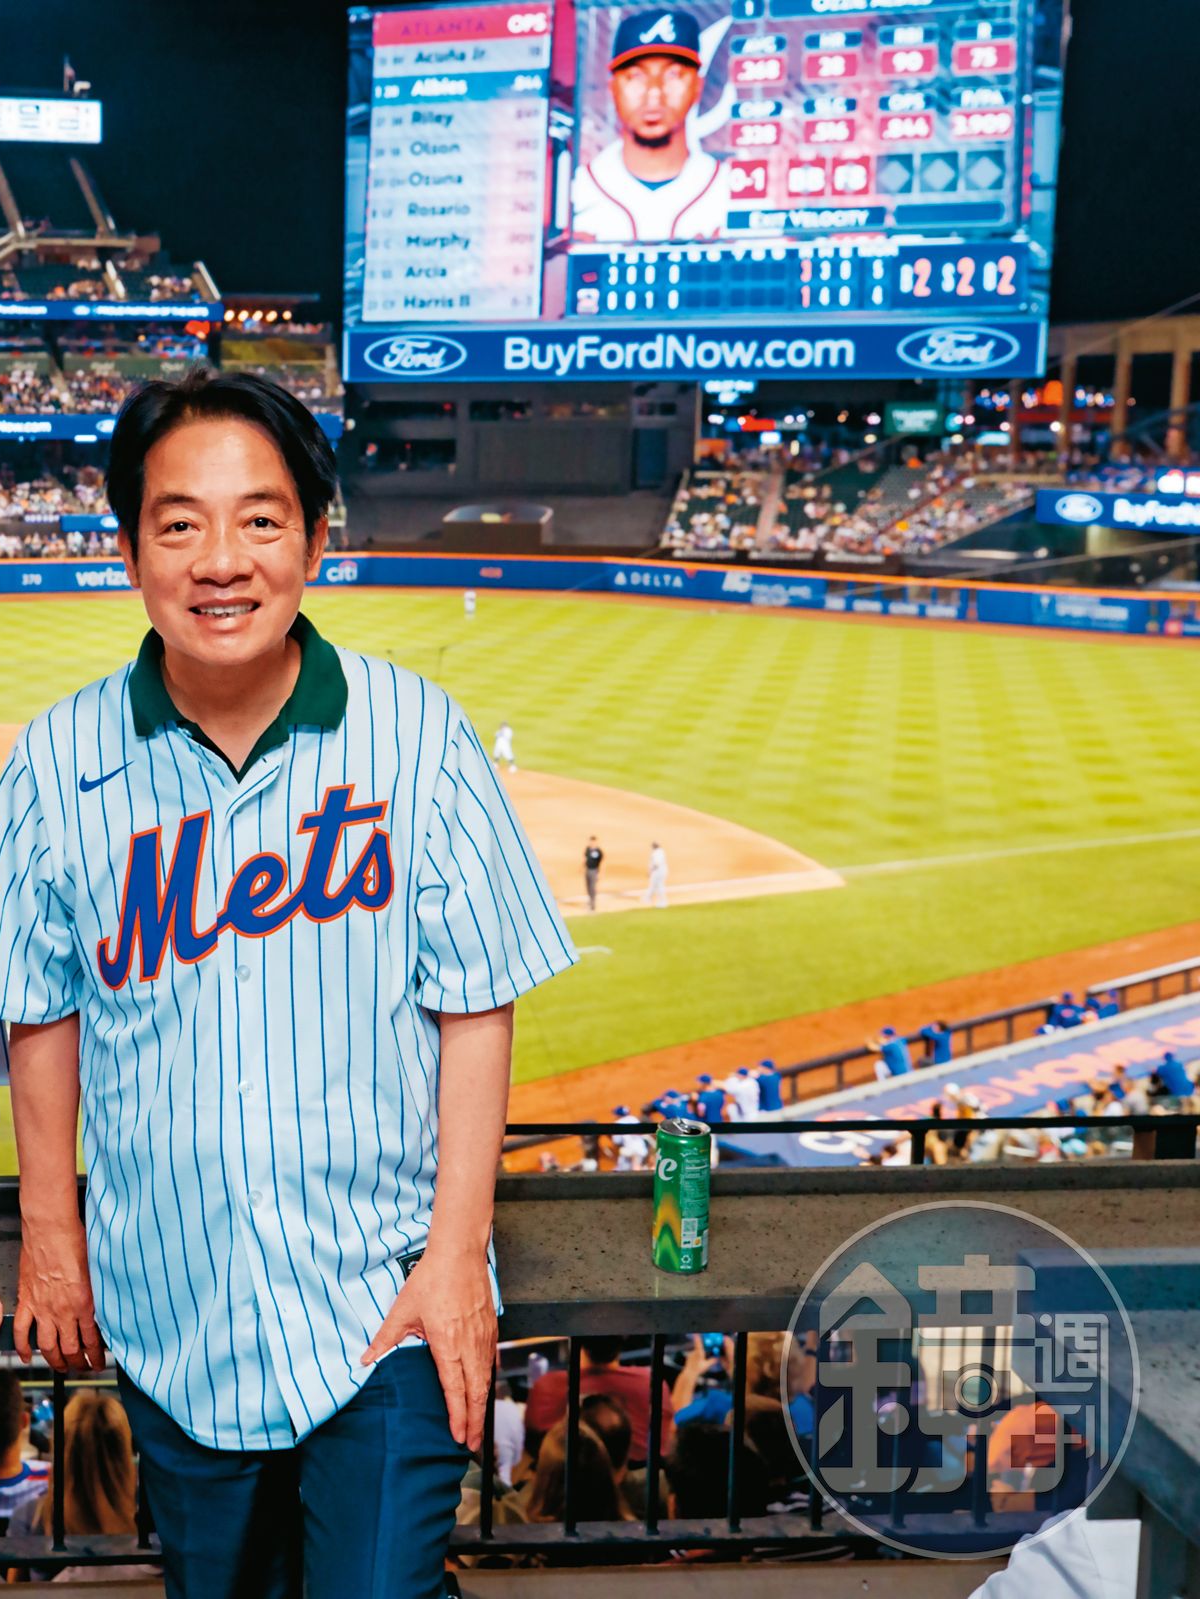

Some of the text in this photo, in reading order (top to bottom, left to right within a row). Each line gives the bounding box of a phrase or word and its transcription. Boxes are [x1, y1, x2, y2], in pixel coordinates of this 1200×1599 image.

[401, 19, 487, 36] ATLANTA
[506, 12, 548, 33] OPS
[410, 77, 468, 97] Albies
[411, 111, 454, 129] Riley
[409, 141, 461, 156] Olson
[408, 171, 464, 188] Ozuna
[407, 202, 471, 217] Rosario
[788, 209, 870, 228] VELOCITY
[406, 233, 471, 250] Murphy
[405, 265, 448, 280] Arcia
[913, 257, 932, 297] 2
[956, 256, 976, 296] 2
[996, 255, 1017, 296] 2
[403, 295, 454, 309] Harris
[382, 337, 447, 370] Ford
[503, 333, 855, 377] BuyFordNow.com
[919, 330, 996, 365] Ford
[75, 566, 131, 587] verizo
[630, 571, 683, 588] DELTA
[96, 783, 395, 991] Mets
